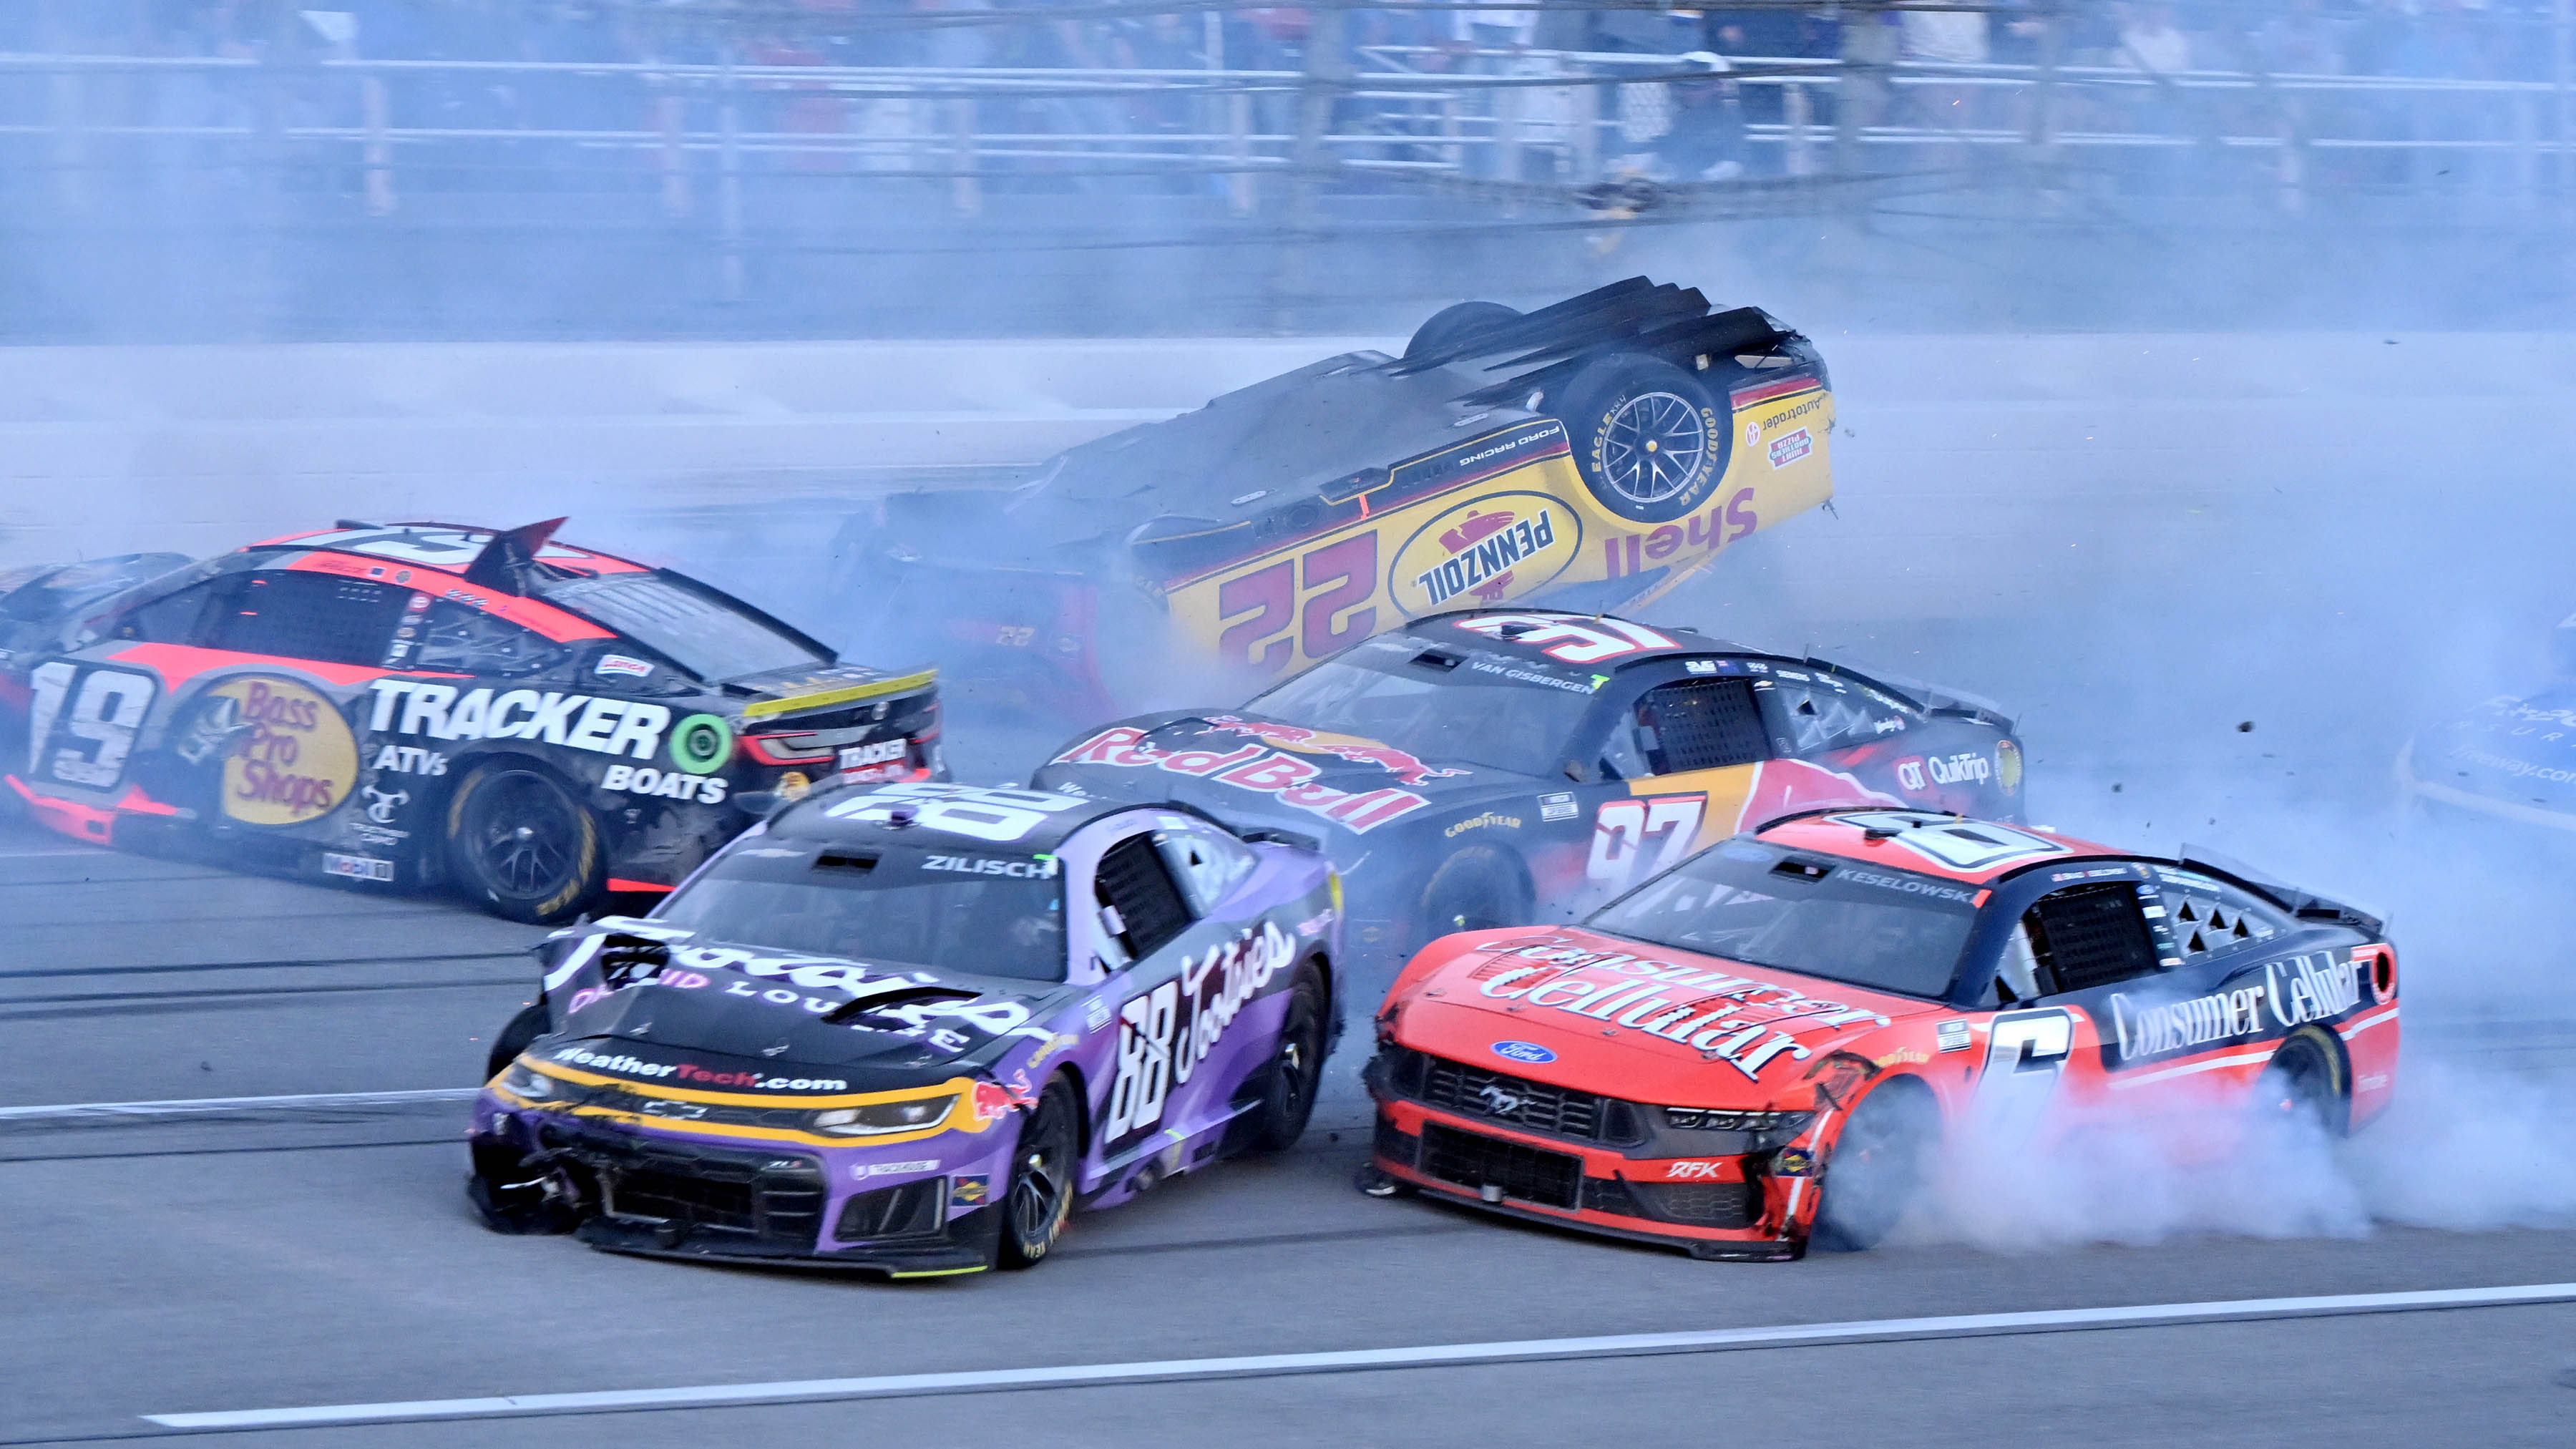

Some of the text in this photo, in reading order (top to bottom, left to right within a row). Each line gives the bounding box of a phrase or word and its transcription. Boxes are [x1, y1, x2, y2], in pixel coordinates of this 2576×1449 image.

[1591, 412, 1613, 472] EAGLE
[1763, 397, 1823, 431] Autotrader
[1460, 426, 1559, 466] FORD RACING
[1679, 408, 1719, 506] GOODYEAR
[1418, 509, 1555, 605] PENNZOIL
[1604, 487, 1757, 580] Shell
[1219, 529, 1377, 674] 22
[243, 681, 319, 731] Bass
[1471, 661, 1596, 695] VAN GISBERGEN
[29, 661, 155, 789] 19
[238, 721, 299, 766] Pro
[368, 679, 671, 761] TRACKER
[371, 745, 450, 776] ATVs
[601, 765, 728, 804] BOATS
[1048, 726, 1432, 834] Red Bull
[1898, 761, 1926, 790] QT
[1928, 753, 1989, 785] QuikTrip
[237, 762, 334, 816] Shops
[824, 782, 1091, 841] 88
[1445, 811, 1522, 837] GOODYEAR
[1586, 795, 1708, 880] 97
[921, 855, 1052, 879] ZILISCH
[1475, 935, 1891, 1031] Consumer
[2111, 950, 2365, 1061] Consumer Cellular
[1480, 966, 1813, 1084] Cellular
[1501, 1042, 1546, 1062] Ford
[552, 1047, 848, 1091] WeatherTech.com
[1105, 980, 1178, 1144] 88
[1666, 1161, 1723, 1178] RFK
